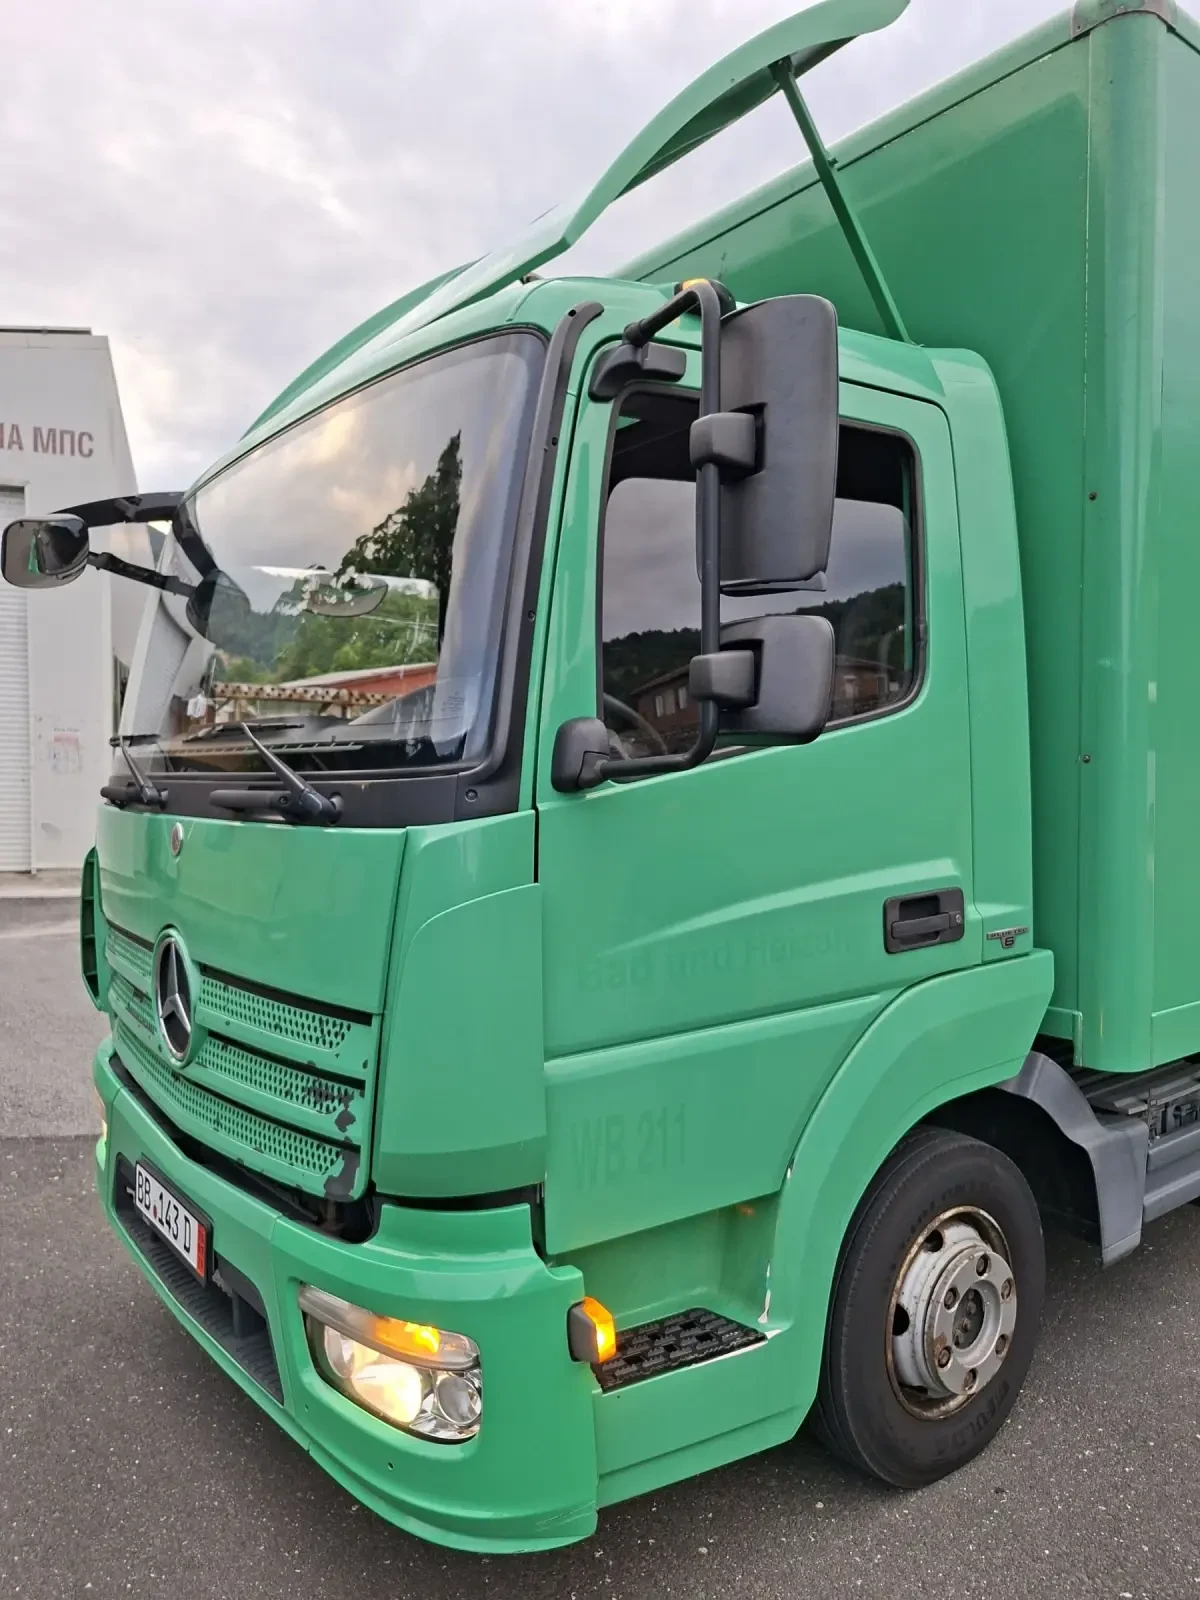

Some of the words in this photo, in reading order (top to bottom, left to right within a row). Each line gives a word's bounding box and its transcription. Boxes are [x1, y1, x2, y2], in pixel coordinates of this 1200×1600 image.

[33, 426, 94, 458] МПС
[1004, 936, 1015, 947] 6
[570, 1114, 626, 1192] WB
[636, 1102, 686, 1175] 211
[138, 1170, 151, 1211] BB
[158, 1191, 179, 1241] 143
[183, 1214, 192, 1254] D
